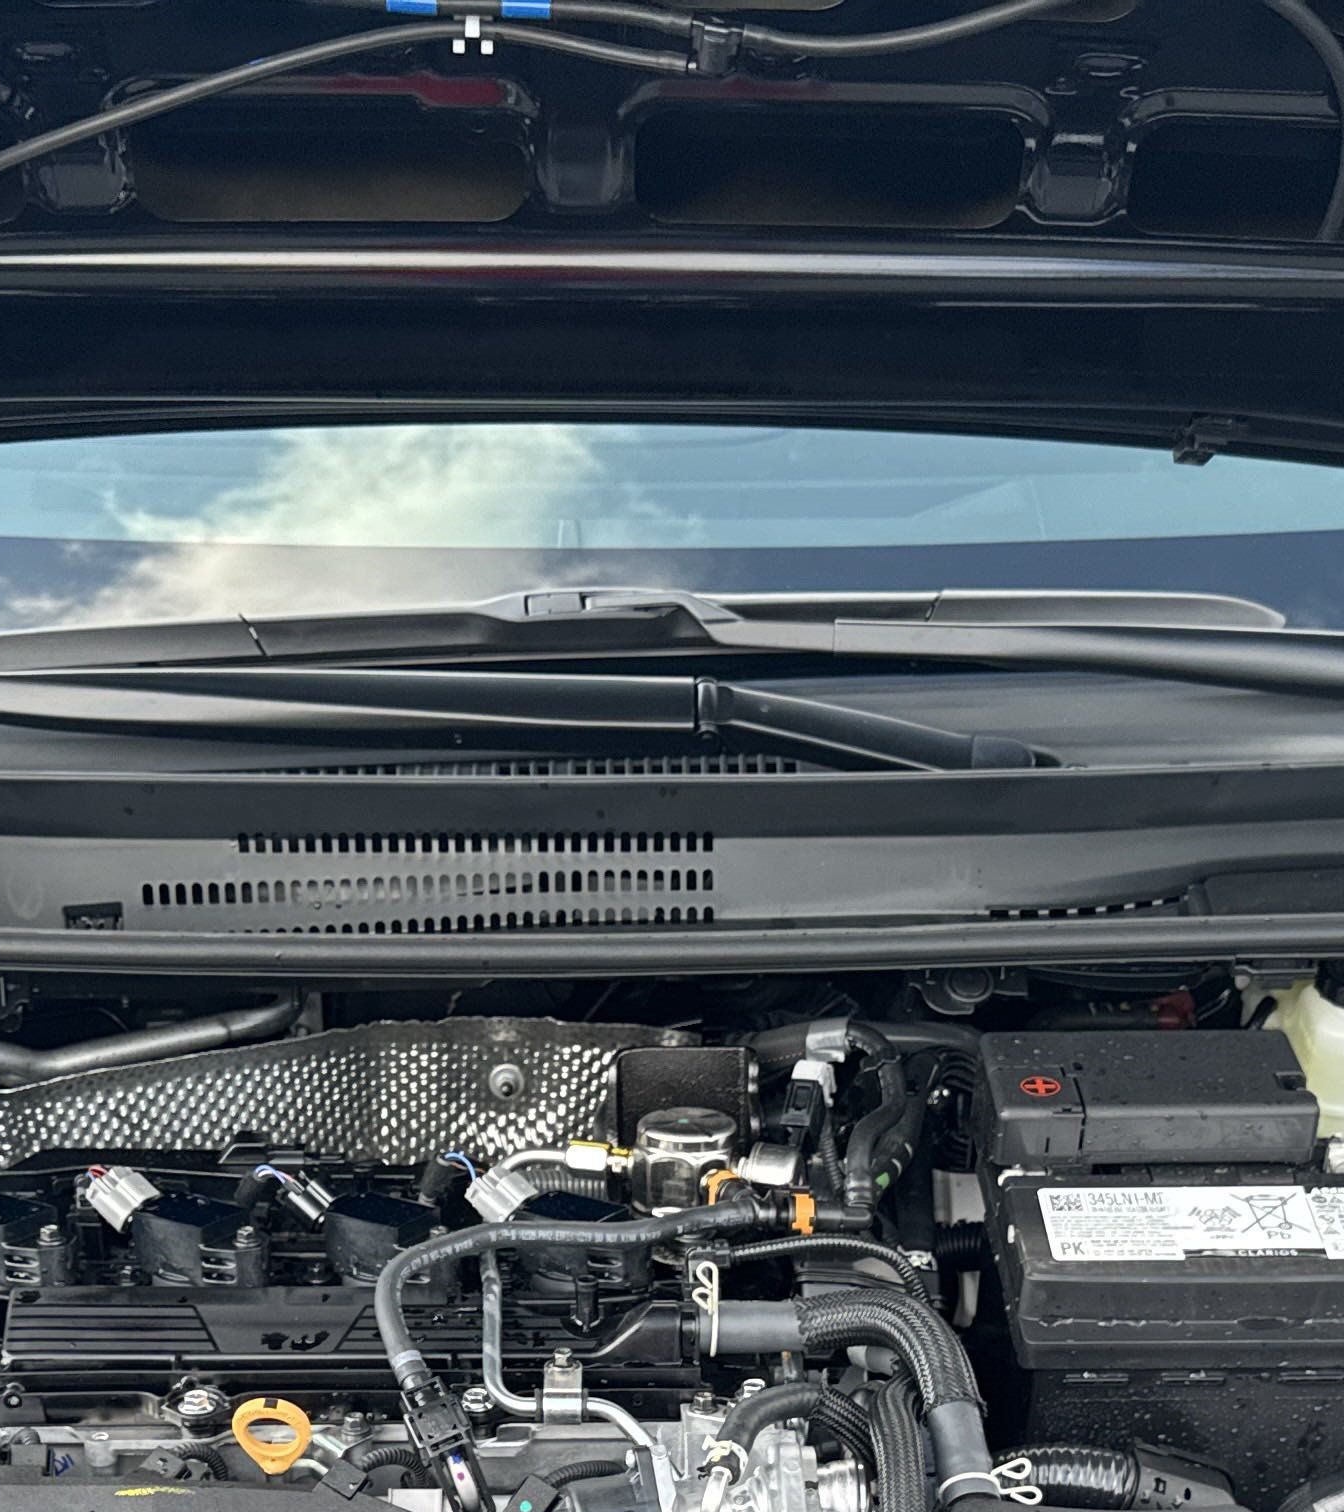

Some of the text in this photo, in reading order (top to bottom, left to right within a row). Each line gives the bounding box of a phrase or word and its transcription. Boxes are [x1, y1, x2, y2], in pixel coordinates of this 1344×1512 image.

[1267, 1230, 1291, 1241] Pb
[1061, 1242, 1085, 1256] PK
[1238, 1249, 1298, 1257] CLARIOS
